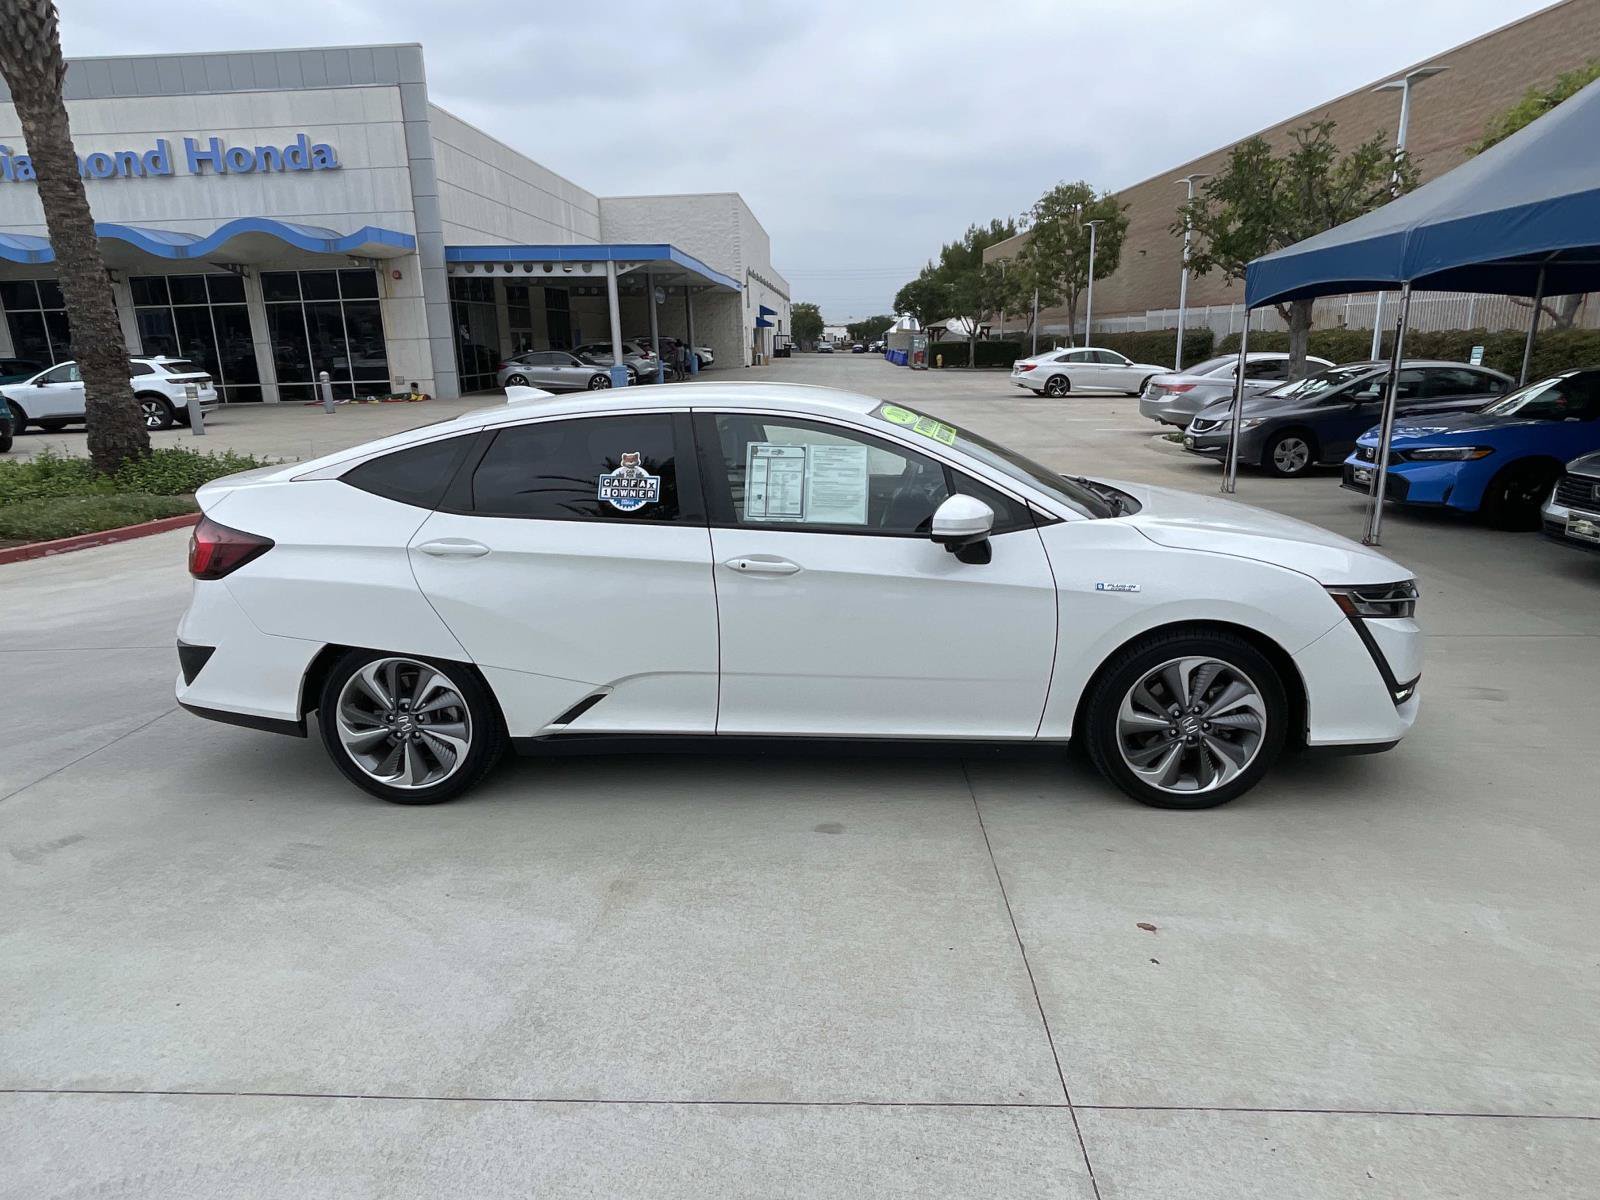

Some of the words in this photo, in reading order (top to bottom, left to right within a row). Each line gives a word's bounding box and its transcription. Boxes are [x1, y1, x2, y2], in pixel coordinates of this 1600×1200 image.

[184, 134, 338, 174] Honda
[603, 479, 655, 489] CARFAX
[612, 489, 655, 498] OWNER
